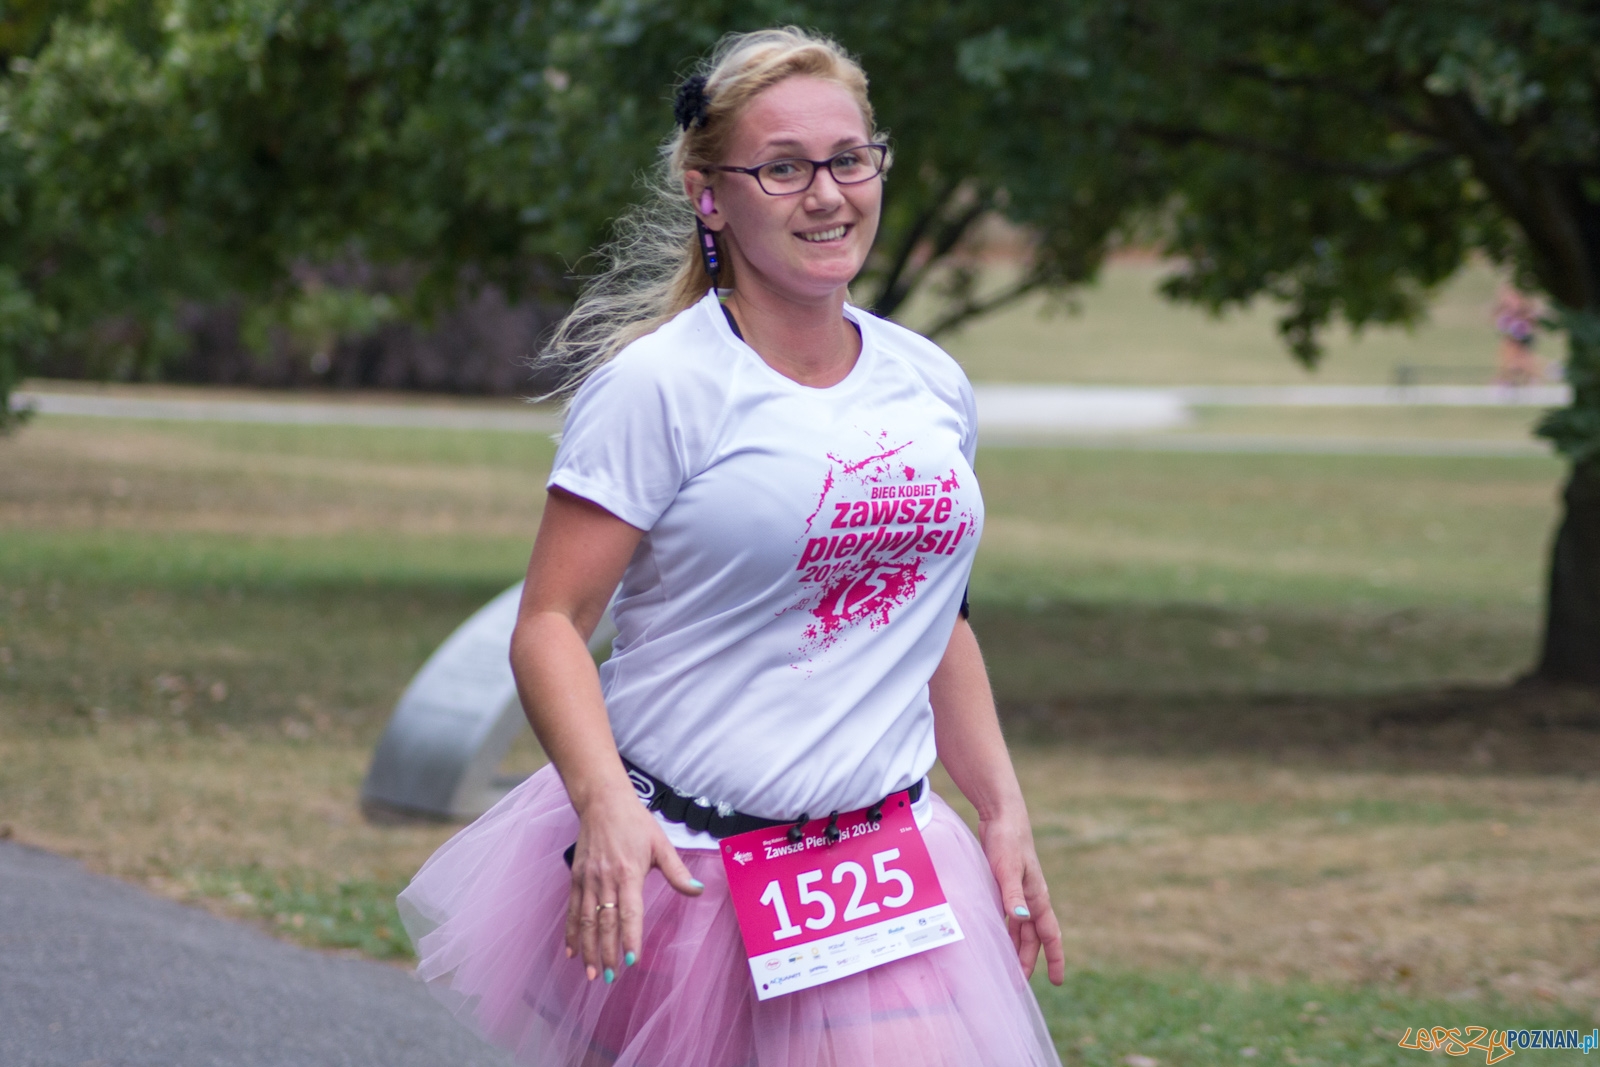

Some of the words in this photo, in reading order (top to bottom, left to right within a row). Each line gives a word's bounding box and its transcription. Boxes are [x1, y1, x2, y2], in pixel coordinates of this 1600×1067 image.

[871, 486, 896, 499] BIEG
[898, 484, 938, 498] KOBIET
[764, 842, 804, 860] Zawsze
[851, 821, 881, 838] 2016
[759, 847, 915, 941] 1525
